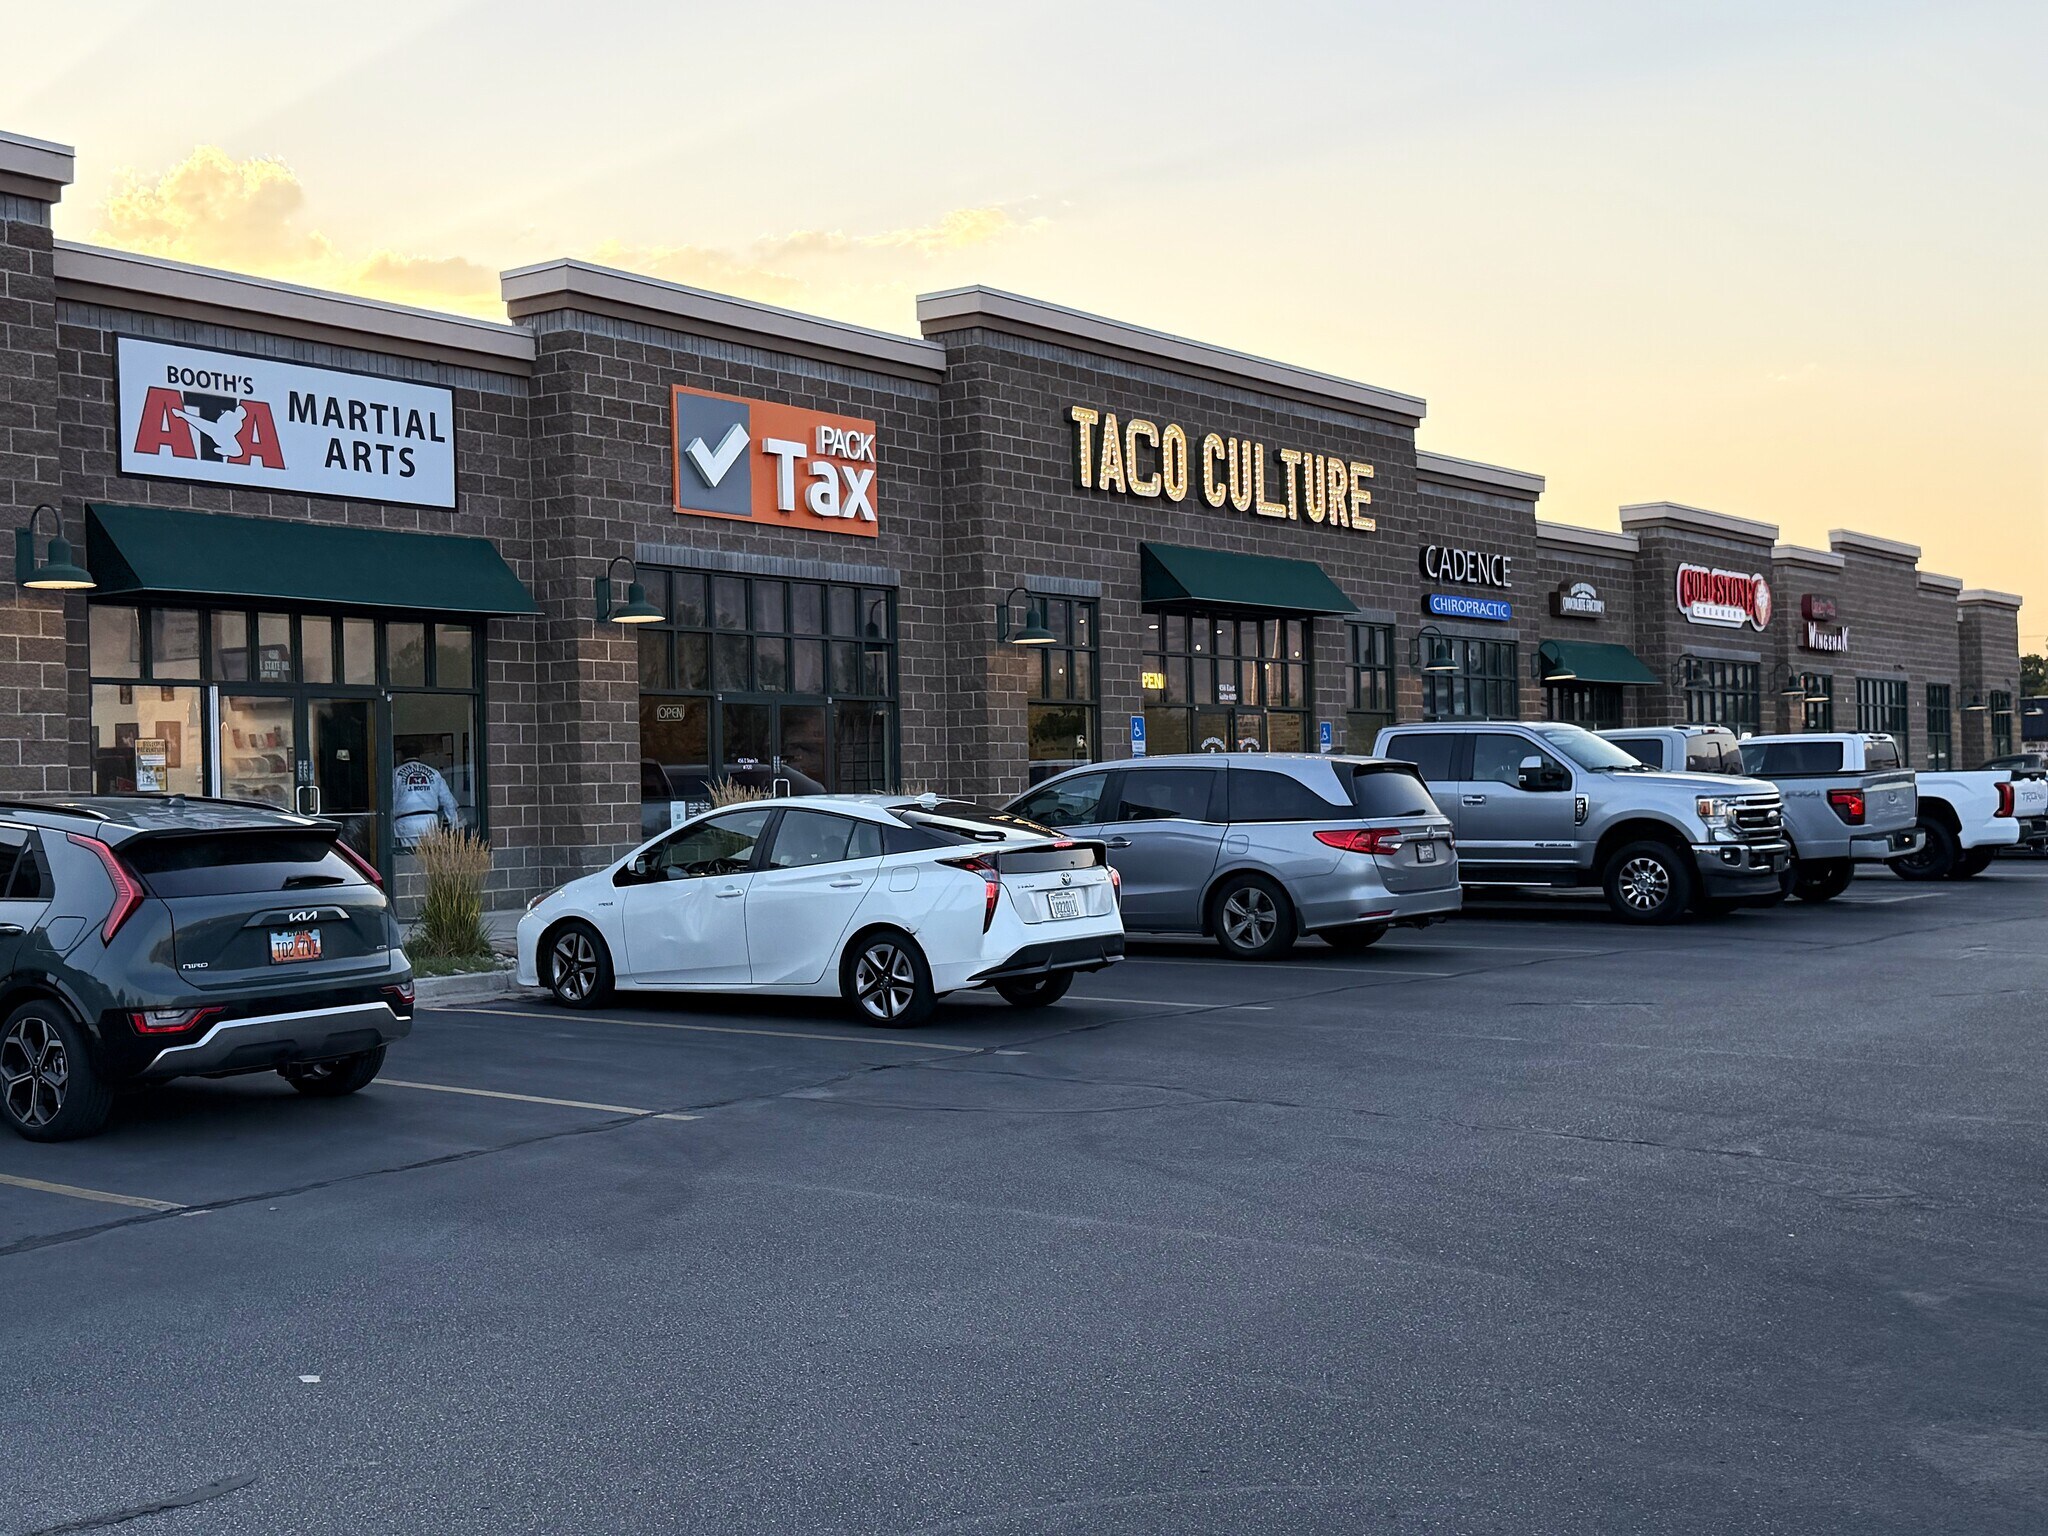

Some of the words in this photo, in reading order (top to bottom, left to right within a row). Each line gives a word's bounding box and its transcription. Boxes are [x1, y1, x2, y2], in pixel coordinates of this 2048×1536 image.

[167, 365, 254, 395] BOOTH'S
[289, 391, 446, 443] MARTIAL
[324, 438, 416, 478] ARTS
[816, 425, 876, 463] PACK
[762, 437, 877, 522] Tax
[1066, 405, 1188, 502] TACO
[1201, 433, 1377, 532] CULTURE
[1425, 545, 1513, 588] CADENCE
[1433, 597, 1508, 618] CHIROPRACTIC
[1682, 569, 1715, 607] COLD
[1716, 574, 1754, 616] STONE
[659, 707, 683, 718] OPEN
[289, 910, 318, 922] KIA
[182, 962, 209, 970] NIRO
